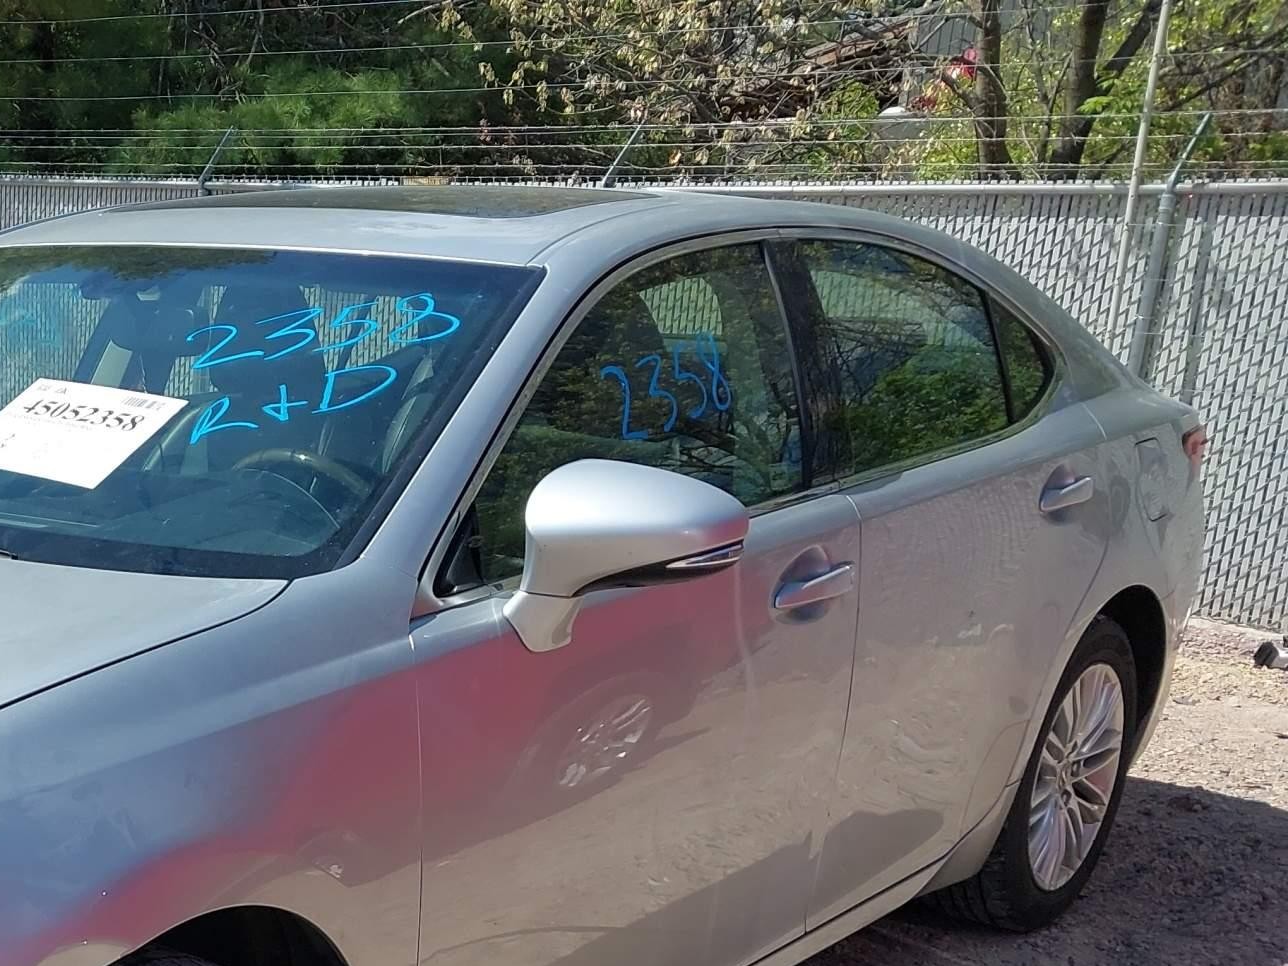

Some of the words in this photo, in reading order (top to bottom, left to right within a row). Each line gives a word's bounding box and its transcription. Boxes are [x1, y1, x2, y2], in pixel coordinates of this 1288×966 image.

[187, 293, 460, 369] 2358
[24, 399, 145, 432] 45052358
[190, 396, 259, 445] R
[312, 365, 397, 414] D
[600, 331, 731, 441] 2358
